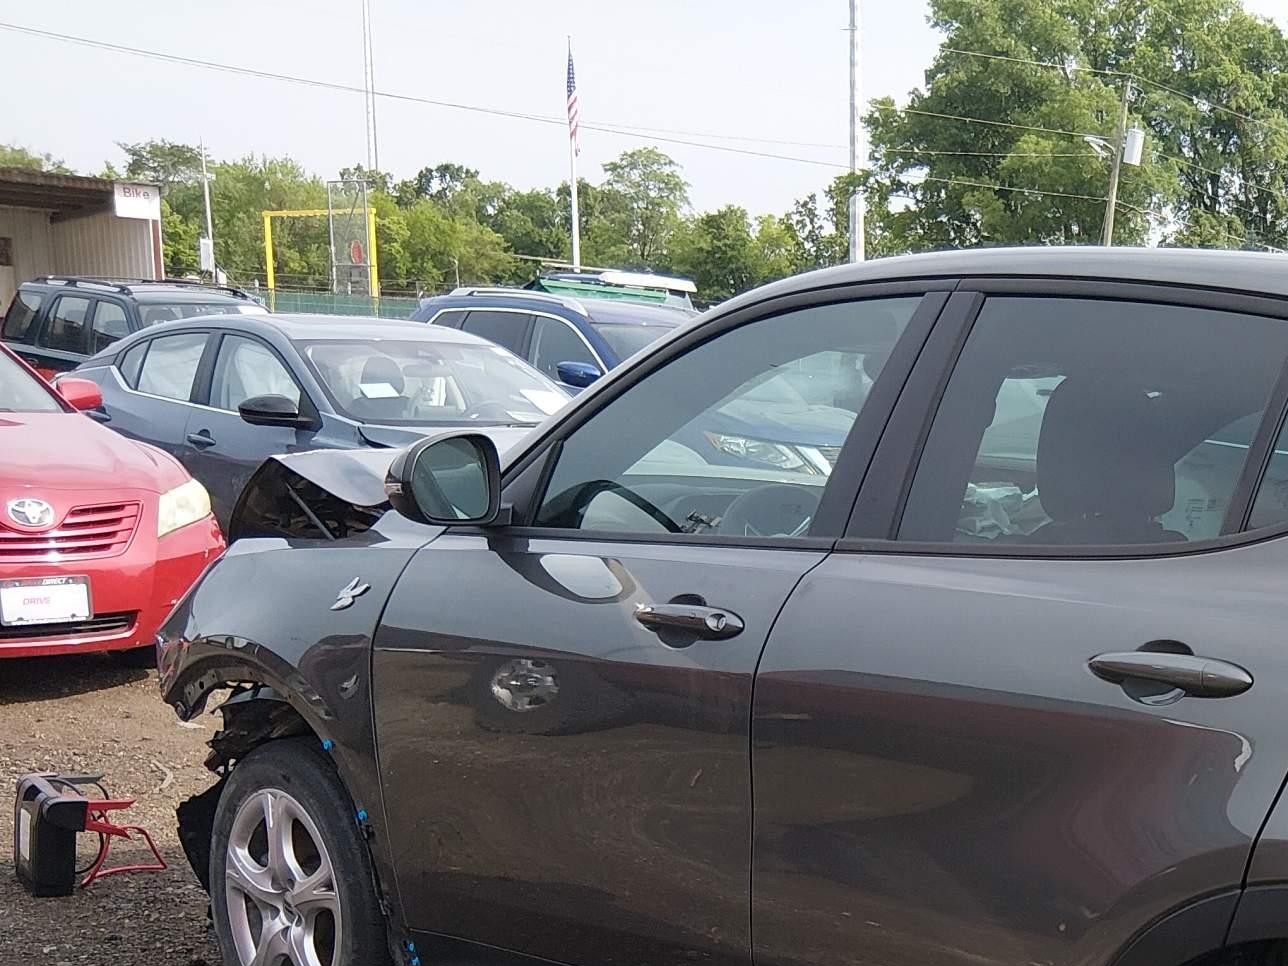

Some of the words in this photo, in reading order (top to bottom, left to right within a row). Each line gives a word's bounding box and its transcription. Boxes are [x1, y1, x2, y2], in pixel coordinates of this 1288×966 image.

[122, 187, 150, 200] Bike
[42, 577, 67, 585] DIRECT
[22, 596, 52, 606] DRIVE
